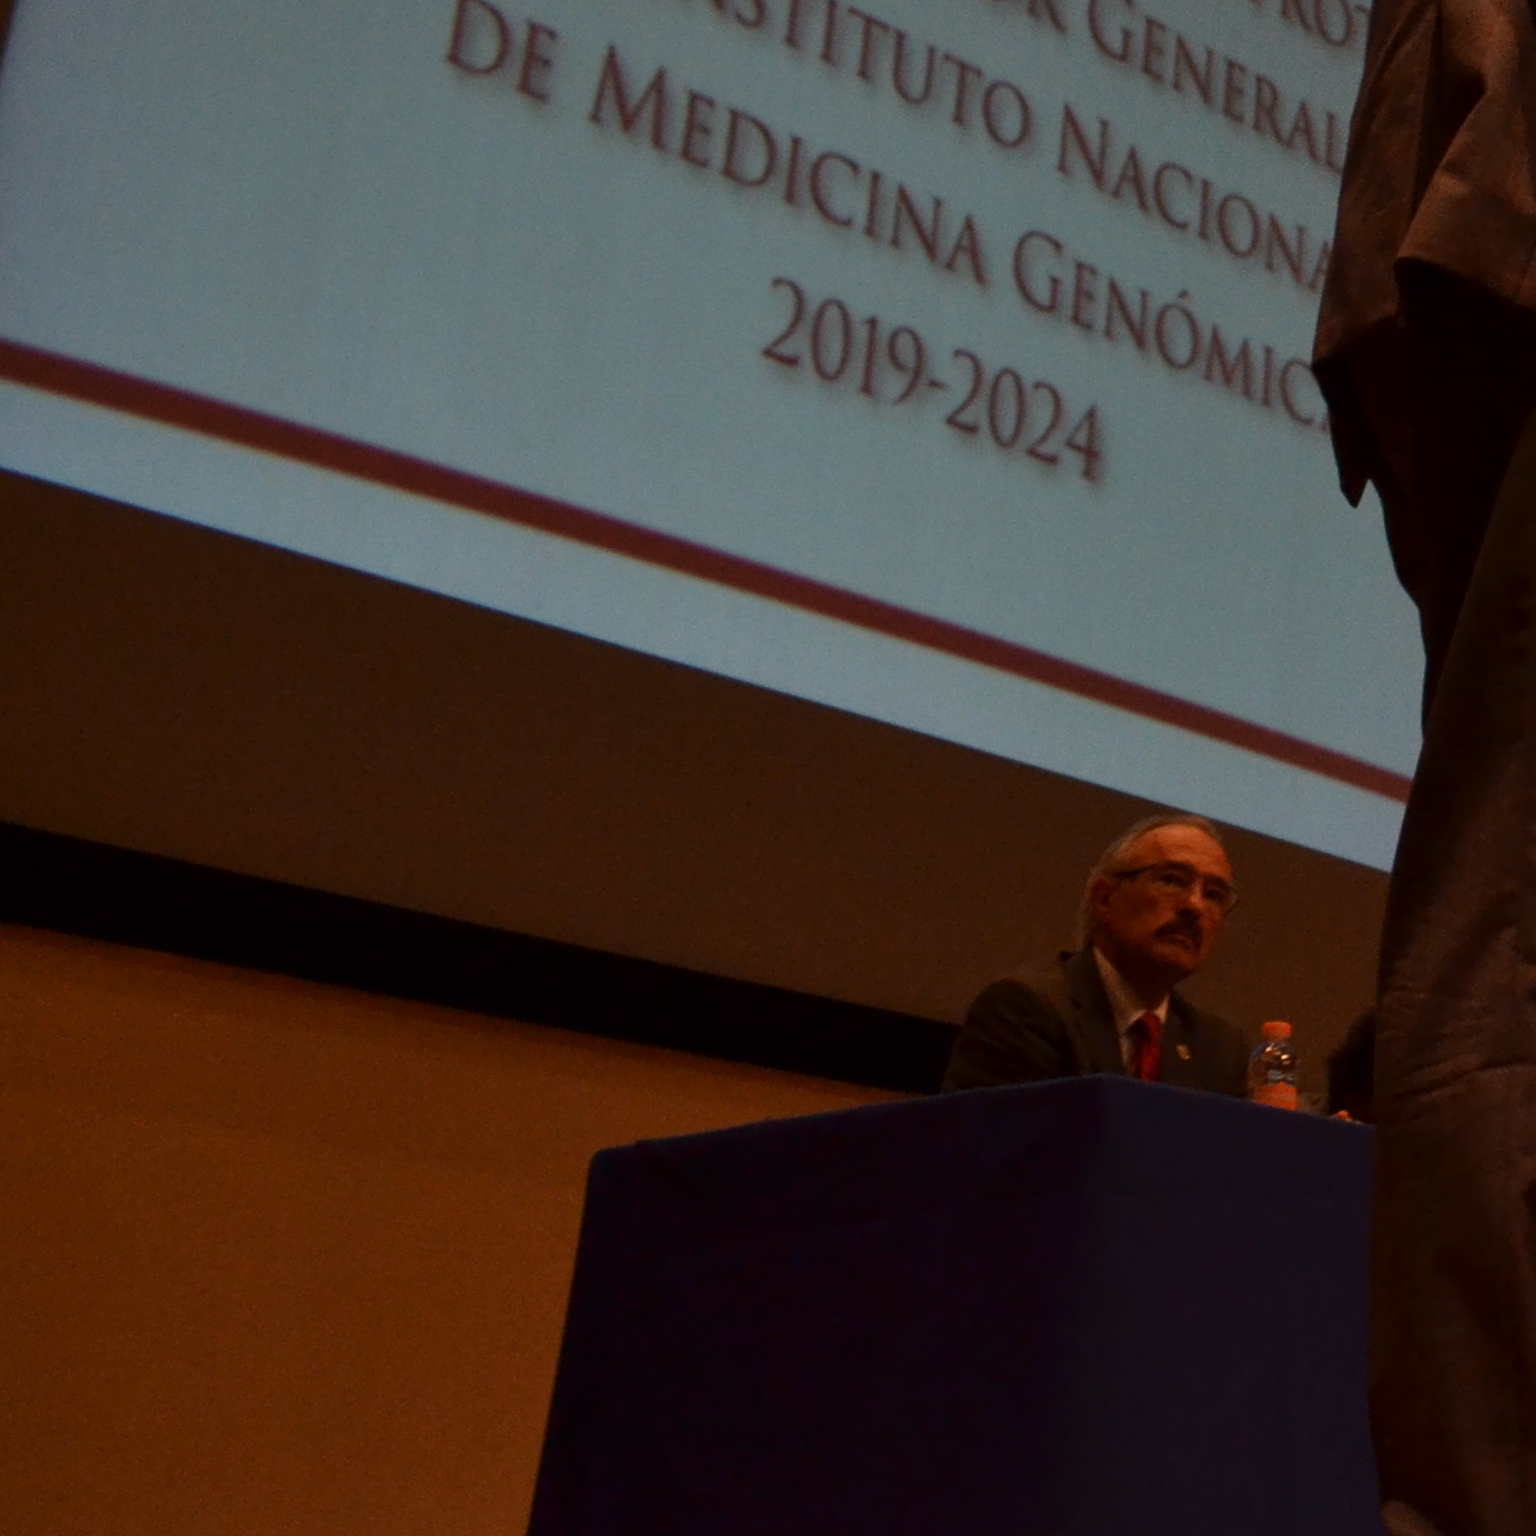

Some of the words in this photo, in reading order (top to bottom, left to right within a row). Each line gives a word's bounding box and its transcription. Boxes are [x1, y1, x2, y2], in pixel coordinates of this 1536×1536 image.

[588, 42, 989, 289] MEDICINA
[1012, 230, 1331, 434] GENÓMIC
[1056, 101, 1333, 294] NACIONA
[762, 275, 1102, 484] 2019-2024
